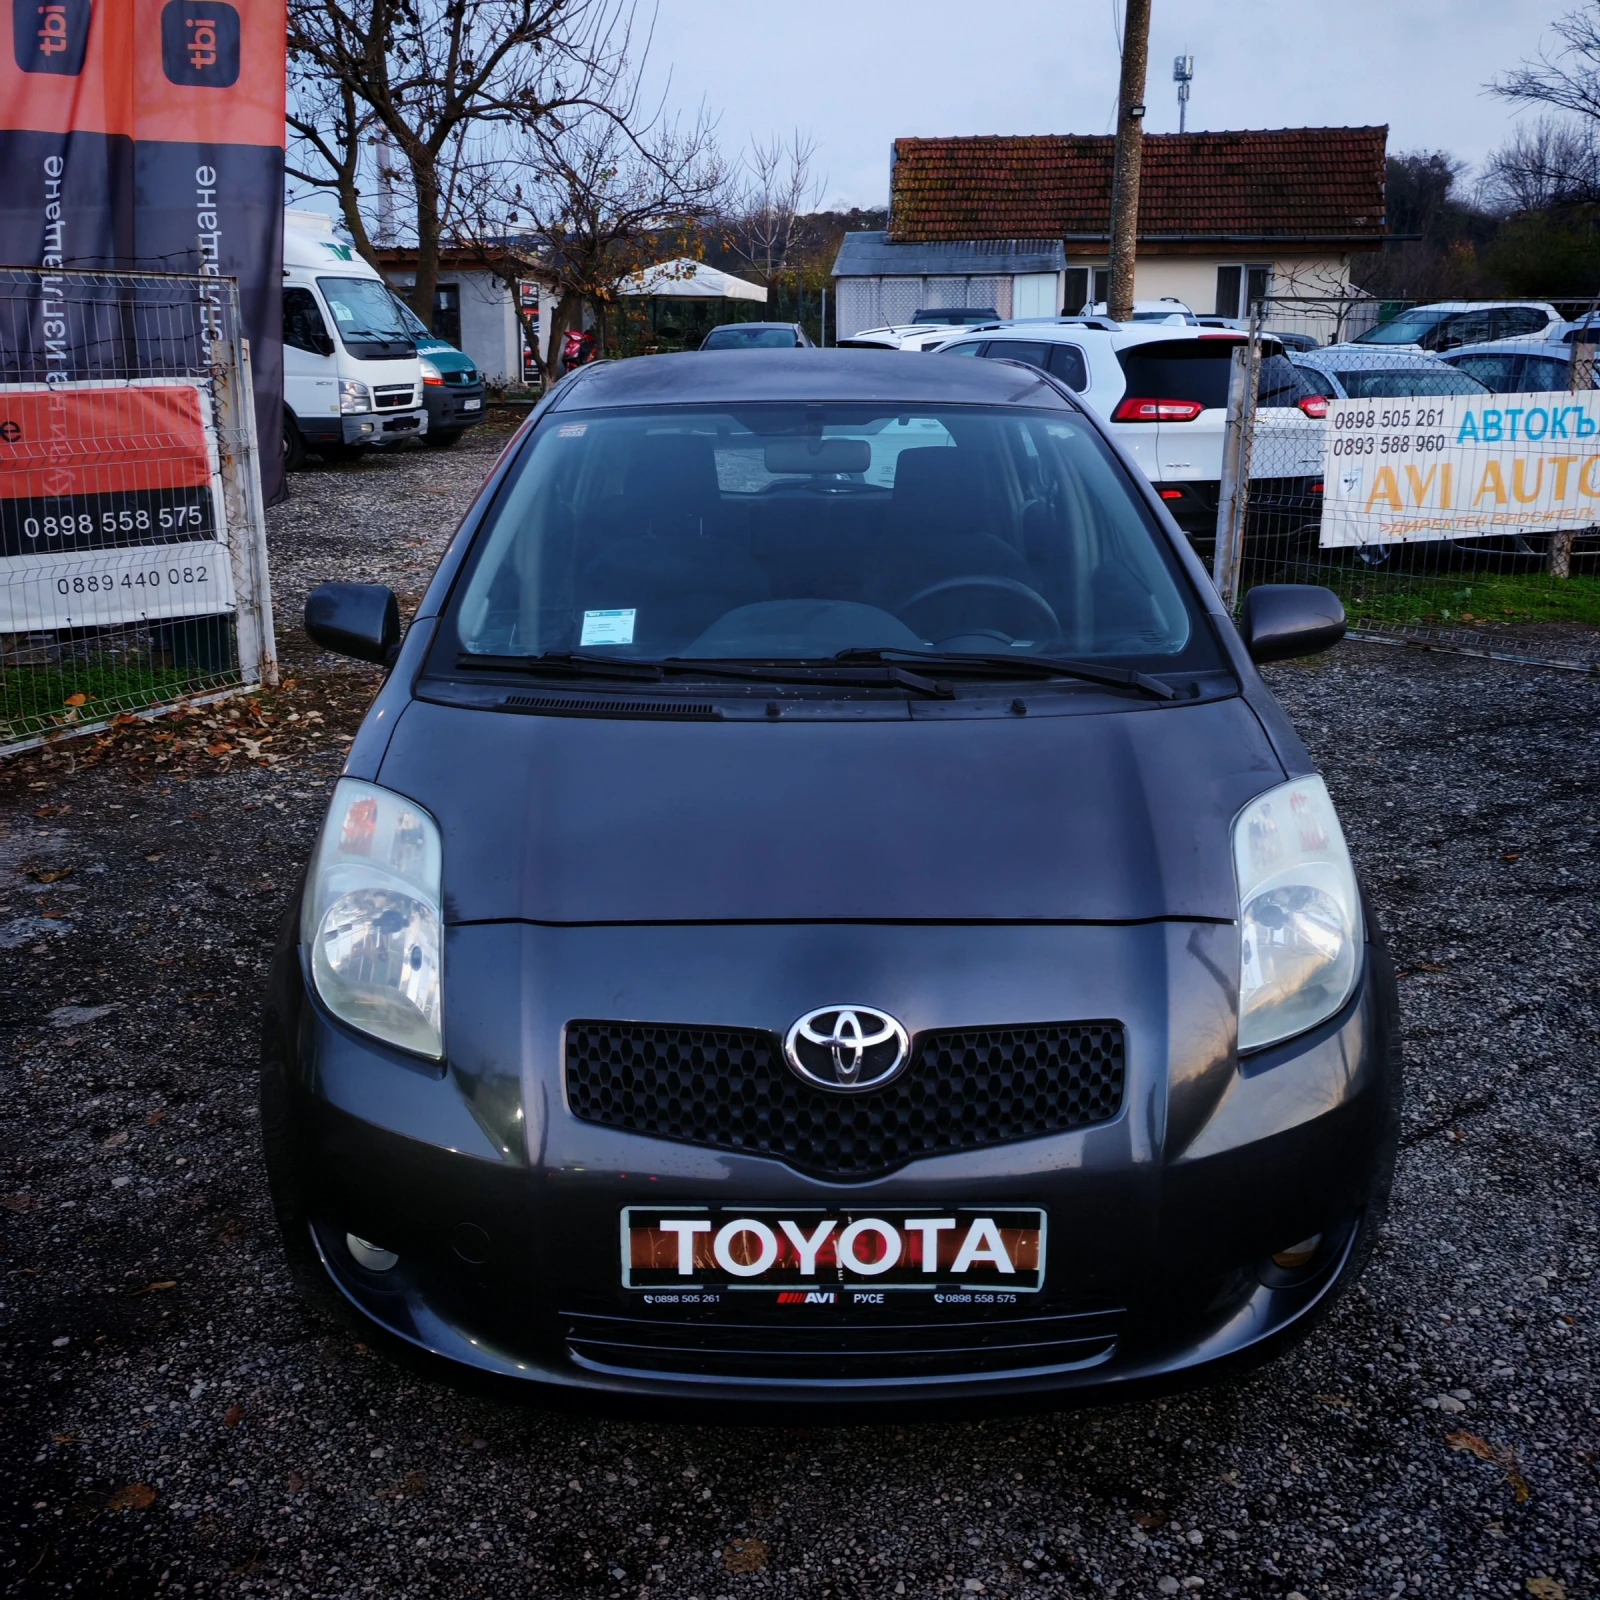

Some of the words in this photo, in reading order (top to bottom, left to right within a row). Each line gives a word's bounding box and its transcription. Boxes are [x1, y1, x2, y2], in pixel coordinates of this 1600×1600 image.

[38, 5, 67, 57] tbi
[186, 18, 217, 70] tbi
[41, 155, 67, 360] изплащане
[1334, 410, 1375, 430] 0898
[1381, 409, 1411, 428] 505
[1416, 408, 1445, 427] 261
[1456, 406, 1600, 444] АВТОКЪ
[1333, 438, 1374, 456] 0893
[1380, 435, 1410, 454] 588
[1416, 434, 1445, 453] 960
[1363, 462, 1453, 513] AVI
[24, 514, 94, 538] 0898
[102, 510, 150, 532] 558
[159, 505, 203, 528] 575
[57, 574, 114, 595] 0889
[121, 570, 160, 589] 440
[168, 566, 209, 585] 082
[659, 1218, 1016, 1277] TOYOTA
[654, 1295, 680, 1303] 0898
[681, 1294, 701, 1303] 505
[702, 1294, 720, 1303] 261
[804, 1292, 835, 1303] AVI
[853, 1293, 885, 1304] РУСЕ
[945, 1294, 972, 1303] 0898
[974, 1294, 995, 1303] 558
[996, 1294, 1017, 1303] 575
